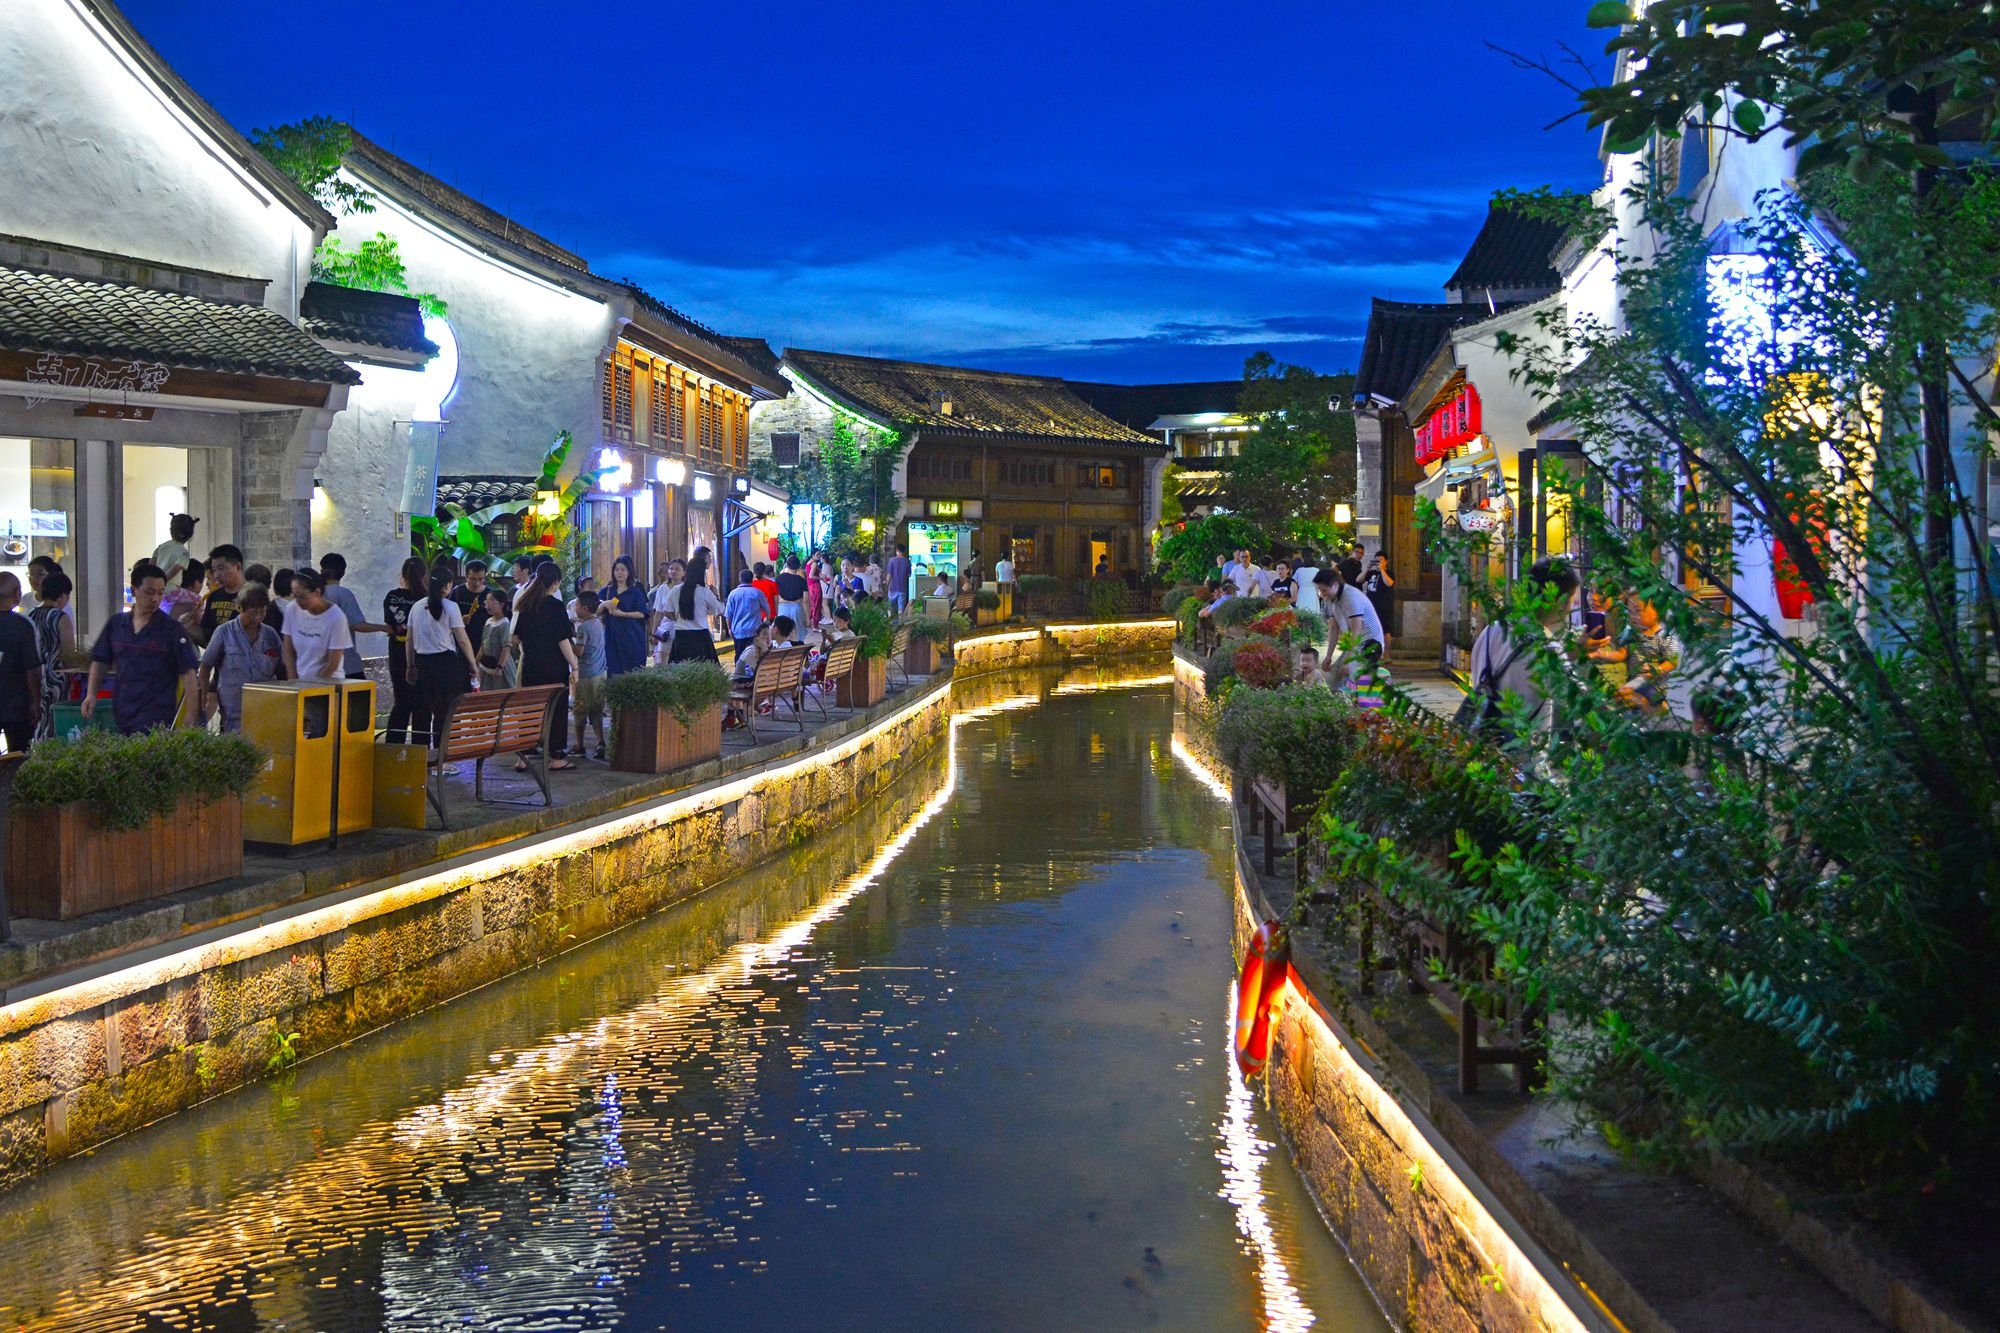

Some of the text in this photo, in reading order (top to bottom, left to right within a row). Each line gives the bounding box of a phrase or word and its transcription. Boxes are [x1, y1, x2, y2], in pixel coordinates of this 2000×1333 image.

[411, 464, 427, 497] 茶点
[1468, 520, 1494, 529] ようこそ
